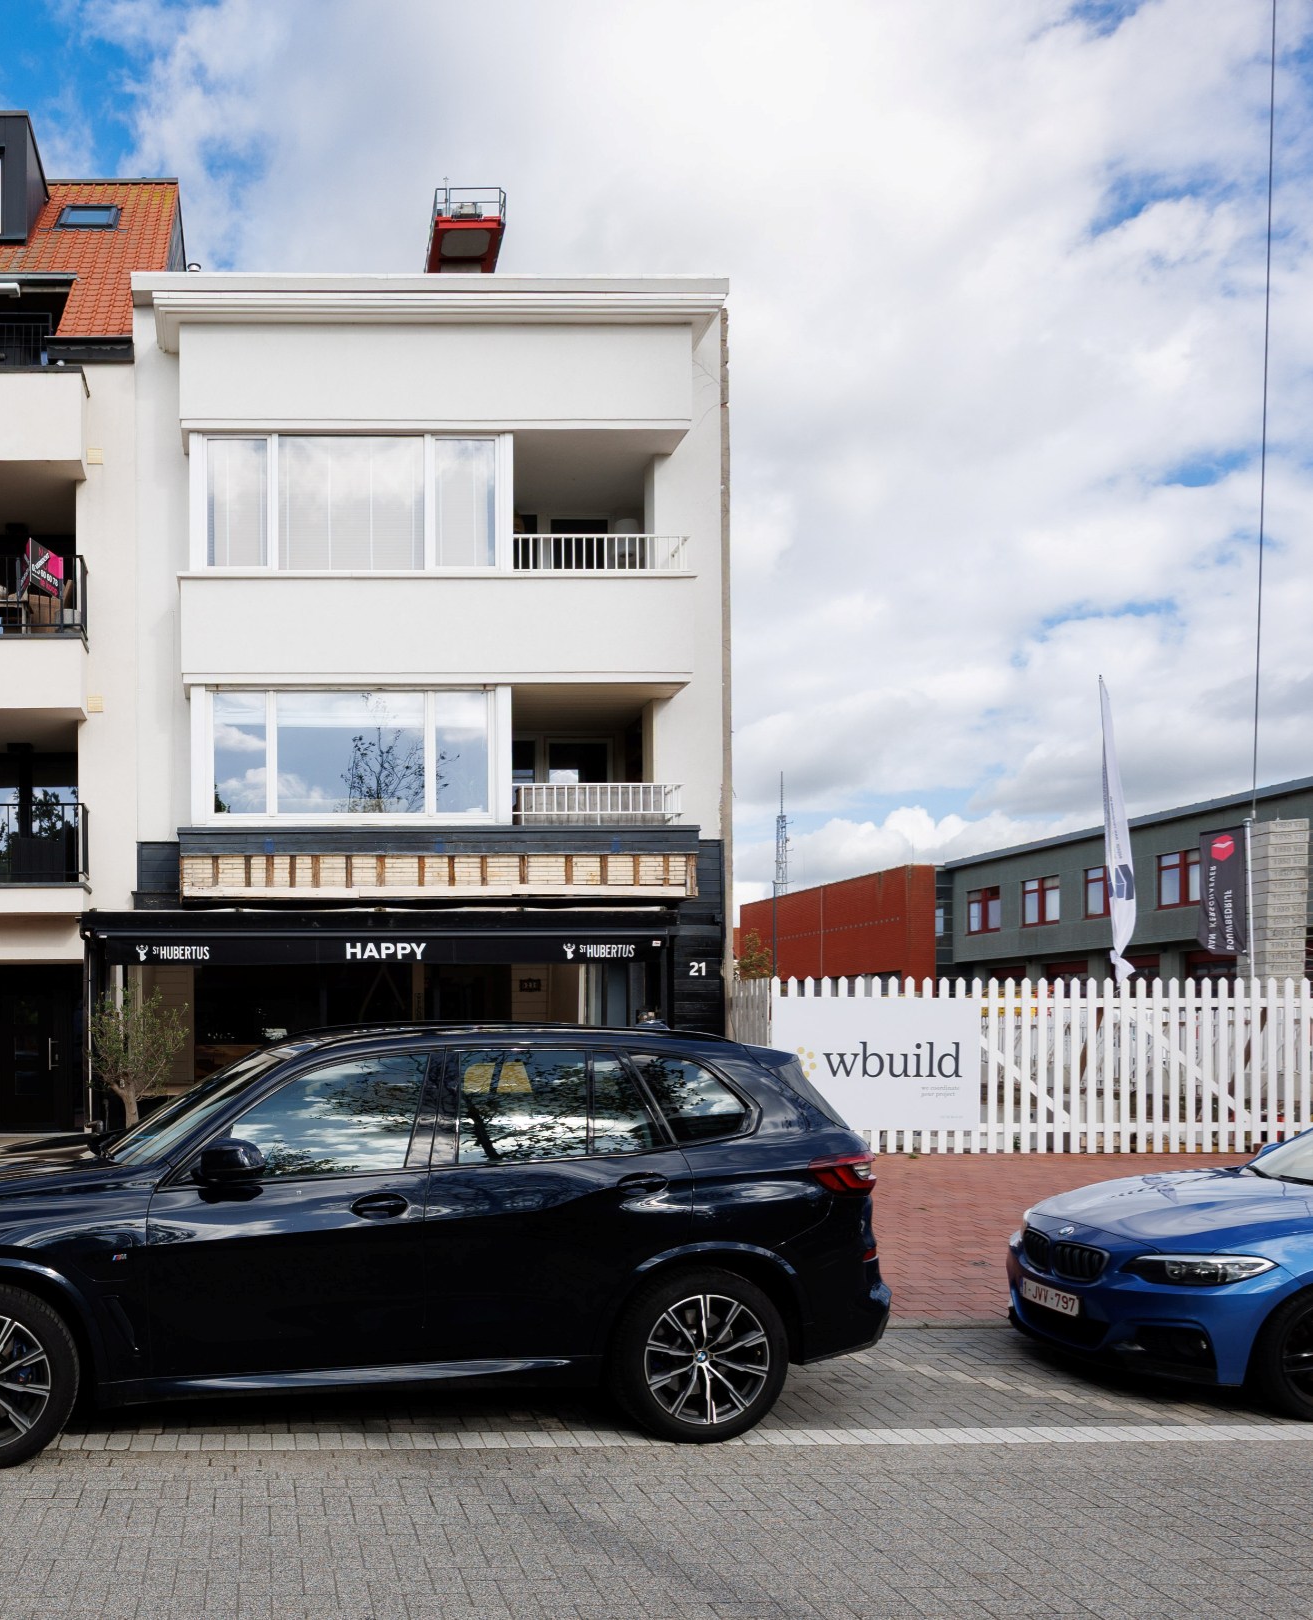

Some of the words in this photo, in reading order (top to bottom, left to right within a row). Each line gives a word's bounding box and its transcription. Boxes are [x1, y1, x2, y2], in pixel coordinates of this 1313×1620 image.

[160, 945, 210, 960] HUBERTUS
[345, 942, 427, 960] HAPPY
[587, 944, 636, 958] HUBERTUS
[689, 961, 707, 976] 21
[822, 1041, 963, 1079] wbuild
